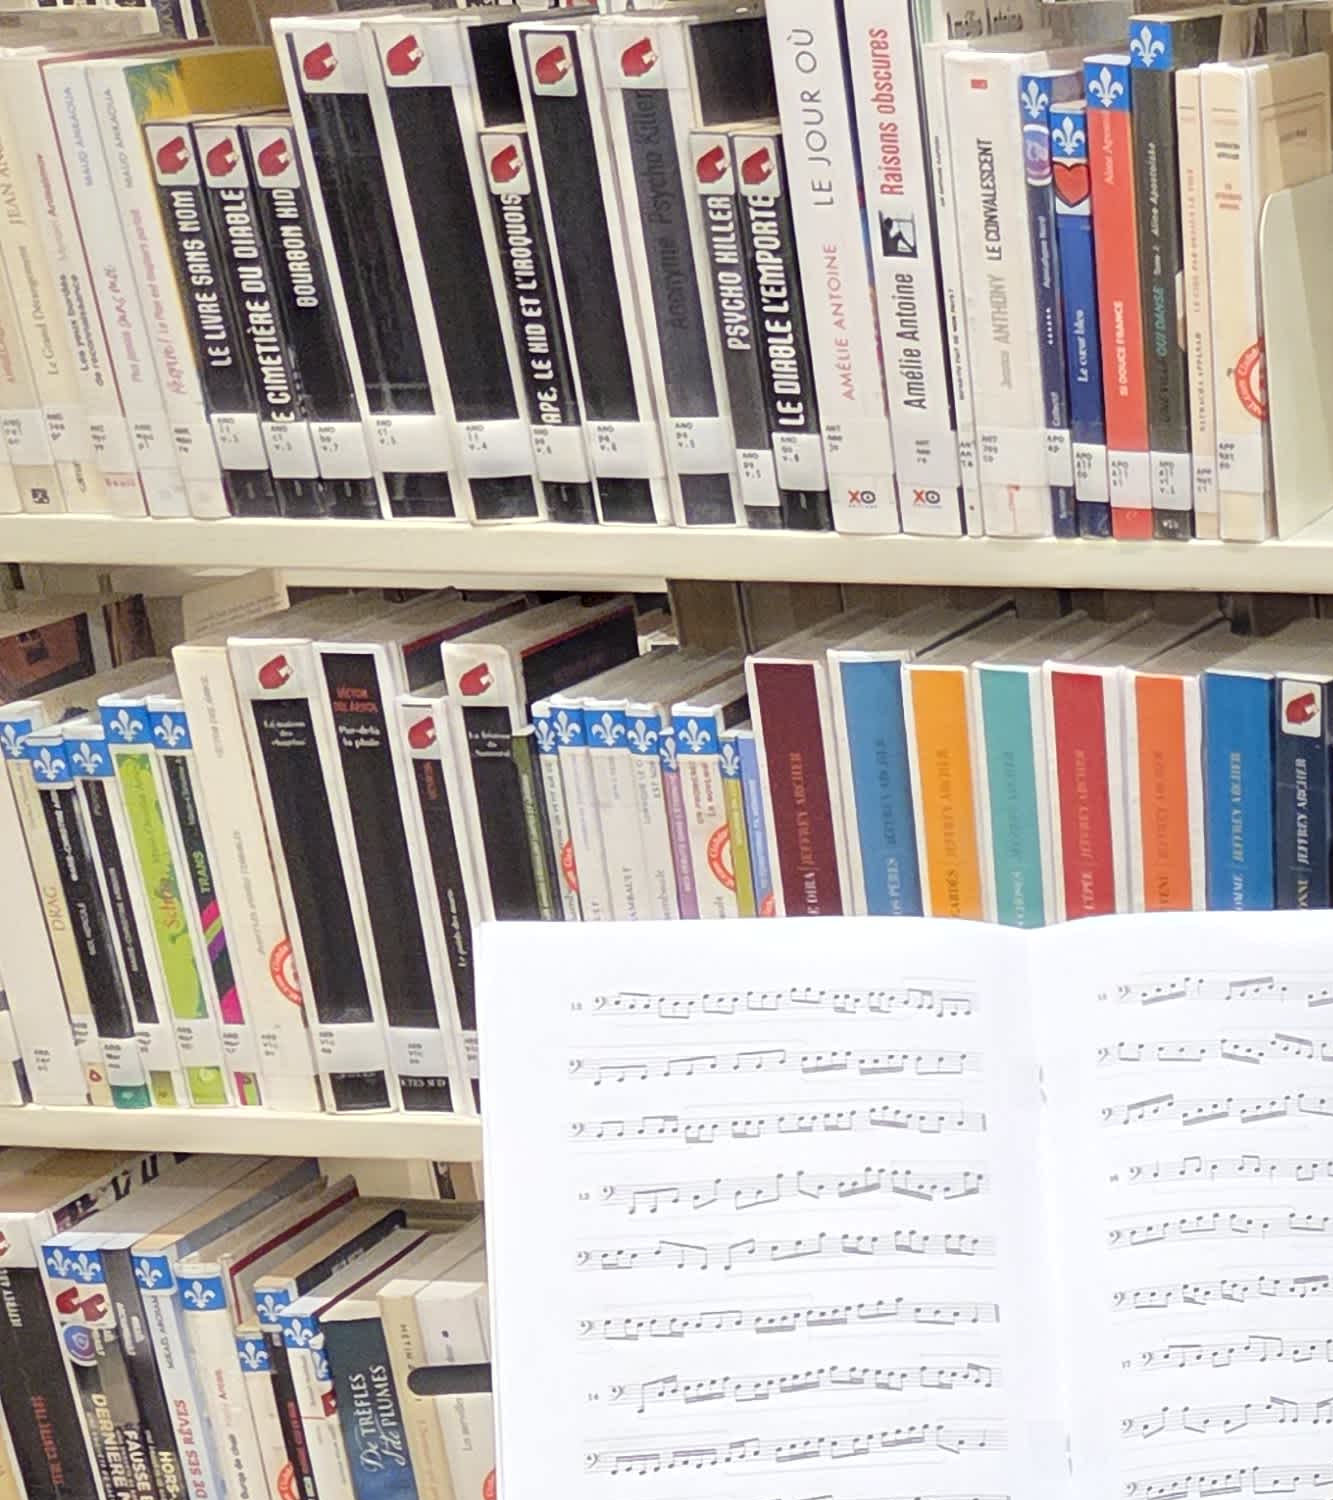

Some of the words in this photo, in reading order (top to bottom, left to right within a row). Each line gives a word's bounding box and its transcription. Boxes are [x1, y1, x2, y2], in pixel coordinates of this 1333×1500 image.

[786, 28, 817, 74] OÙ
[868, 28, 896, 115] obscures
[800, 89, 832, 167] JOUR
[879, 121, 904, 196] Raisons
[171, 190, 200, 232] NOM
[220, 189, 259, 259] DIABLE
[812, 180, 834, 206] LE
[707, 196, 739, 264] KILLER
[987, 246, 1002, 262] LE
[183, 239, 213, 285] SANS
[237, 266, 266, 293] DU
[280, 225, 319, 307] BOURBON
[823, 243, 846, 329] ANTOINE
[195, 292, 226, 340] LIVRE
[520, 296, 542, 318] ET
[718, 272, 751, 351] PSYCHO
[891, 273, 919, 341] Antoine
[208, 346, 232, 366] LE
[245, 300, 291, 405] CIMETIÈRE
[525, 324, 549, 353] KID
[533, 358, 554, 380] LE
[764, 319, 802, 394] DIABLE
[832, 335, 855, 401] AMÉLIE
[898, 347, 927, 410] Amélie
[776, 400, 805, 426] LE
[175, 1400, 194, 1445] RÊVES
[349, 1373, 376, 1437] TRÈFLES
[369, 1364, 398, 1427] PLUMES
[124, 1429, 150, 1491] FAUSSE
[186, 1449, 201, 1476] SES
[195, 1481, 208, 1498] DE
